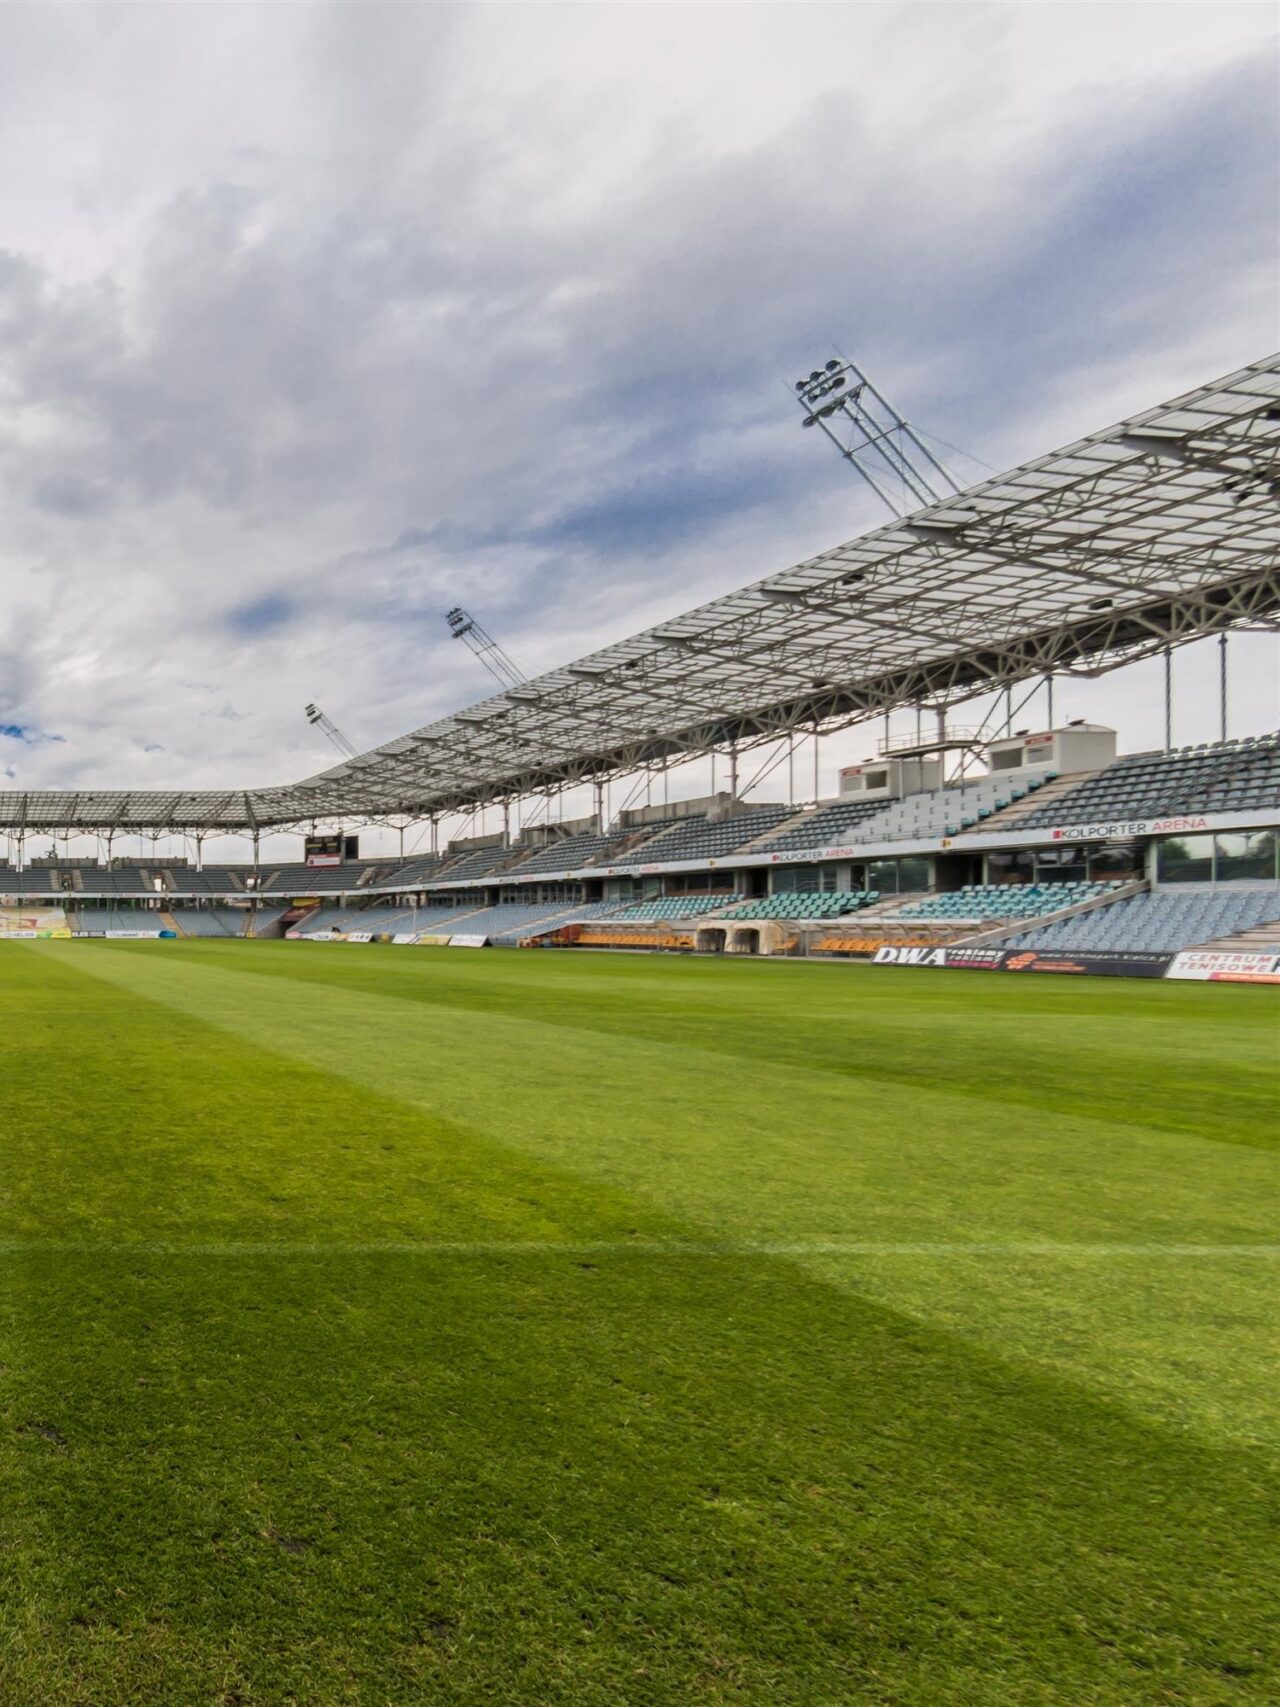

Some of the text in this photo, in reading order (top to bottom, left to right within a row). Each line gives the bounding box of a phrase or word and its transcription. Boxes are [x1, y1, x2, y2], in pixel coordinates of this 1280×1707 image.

[1060, 818, 1208, 839] KOLPORTER ARENA
[825, 848, 854, 857] ARENA
[1187, 954, 1272, 963] CENTRUM
[1179, 962, 1269, 972] TENISOWE
